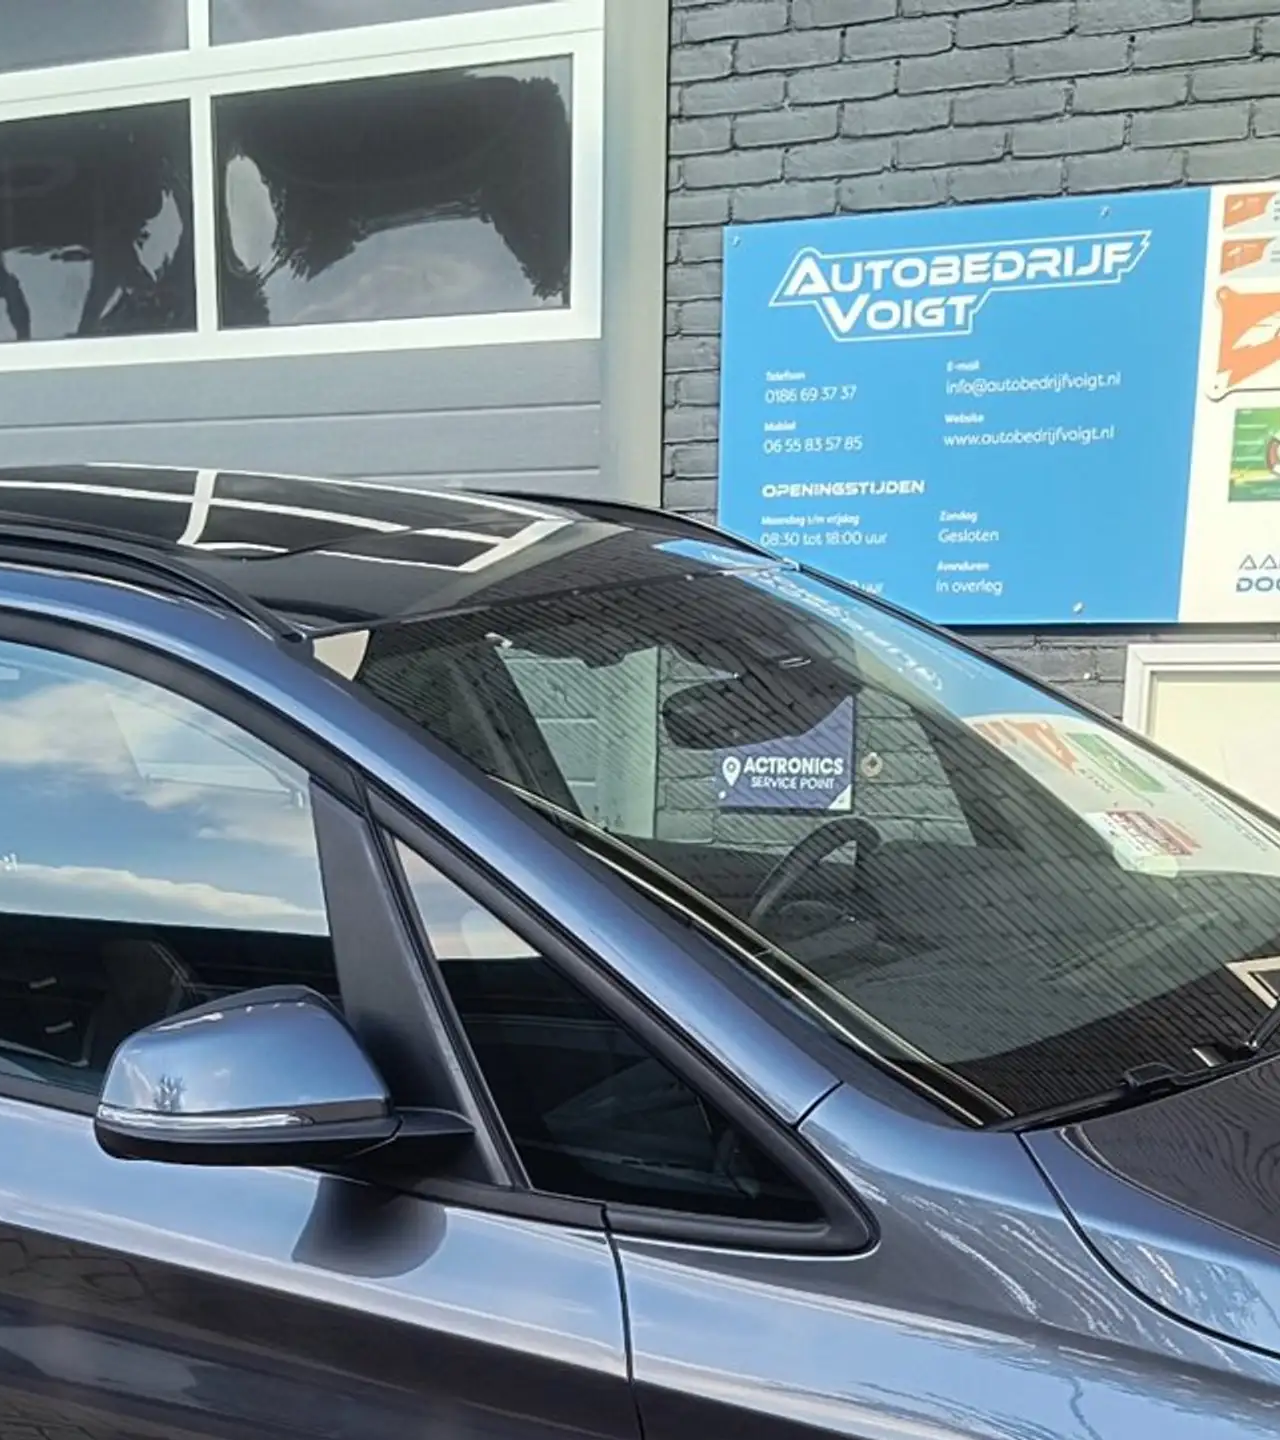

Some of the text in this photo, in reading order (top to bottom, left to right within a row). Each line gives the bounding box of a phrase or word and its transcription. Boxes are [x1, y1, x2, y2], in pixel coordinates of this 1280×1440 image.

[784, 241, 1134, 296] AUTOBEDRIJF
[822, 294, 978, 333] VOIGT
[800, 387, 818, 402] 69
[821, 386, 837, 401] 37
[840, 384, 857, 400] 37
[946, 371, 1122, 397] info@autobedrijfvoigt.nl
[944, 412, 985, 424] Website
[763, 438, 781, 453] 06
[805, 437, 822, 451] 83
[824, 436, 841, 451] 57
[843, 435, 863, 450] 85
[943, 425, 1116, 445] www.autobedrijfvoigt.nl
[762, 480, 925, 497] OPENINGSTIJDEN
[803, 532, 823, 546] tot
[865, 532, 888, 545] uur
[937, 528, 1000, 543] Gesloten
[952, 578, 1003, 596] overleg
[743, 756, 844, 775] ACTRONICS
[750, 776, 835, 790] SERVICE POINT
